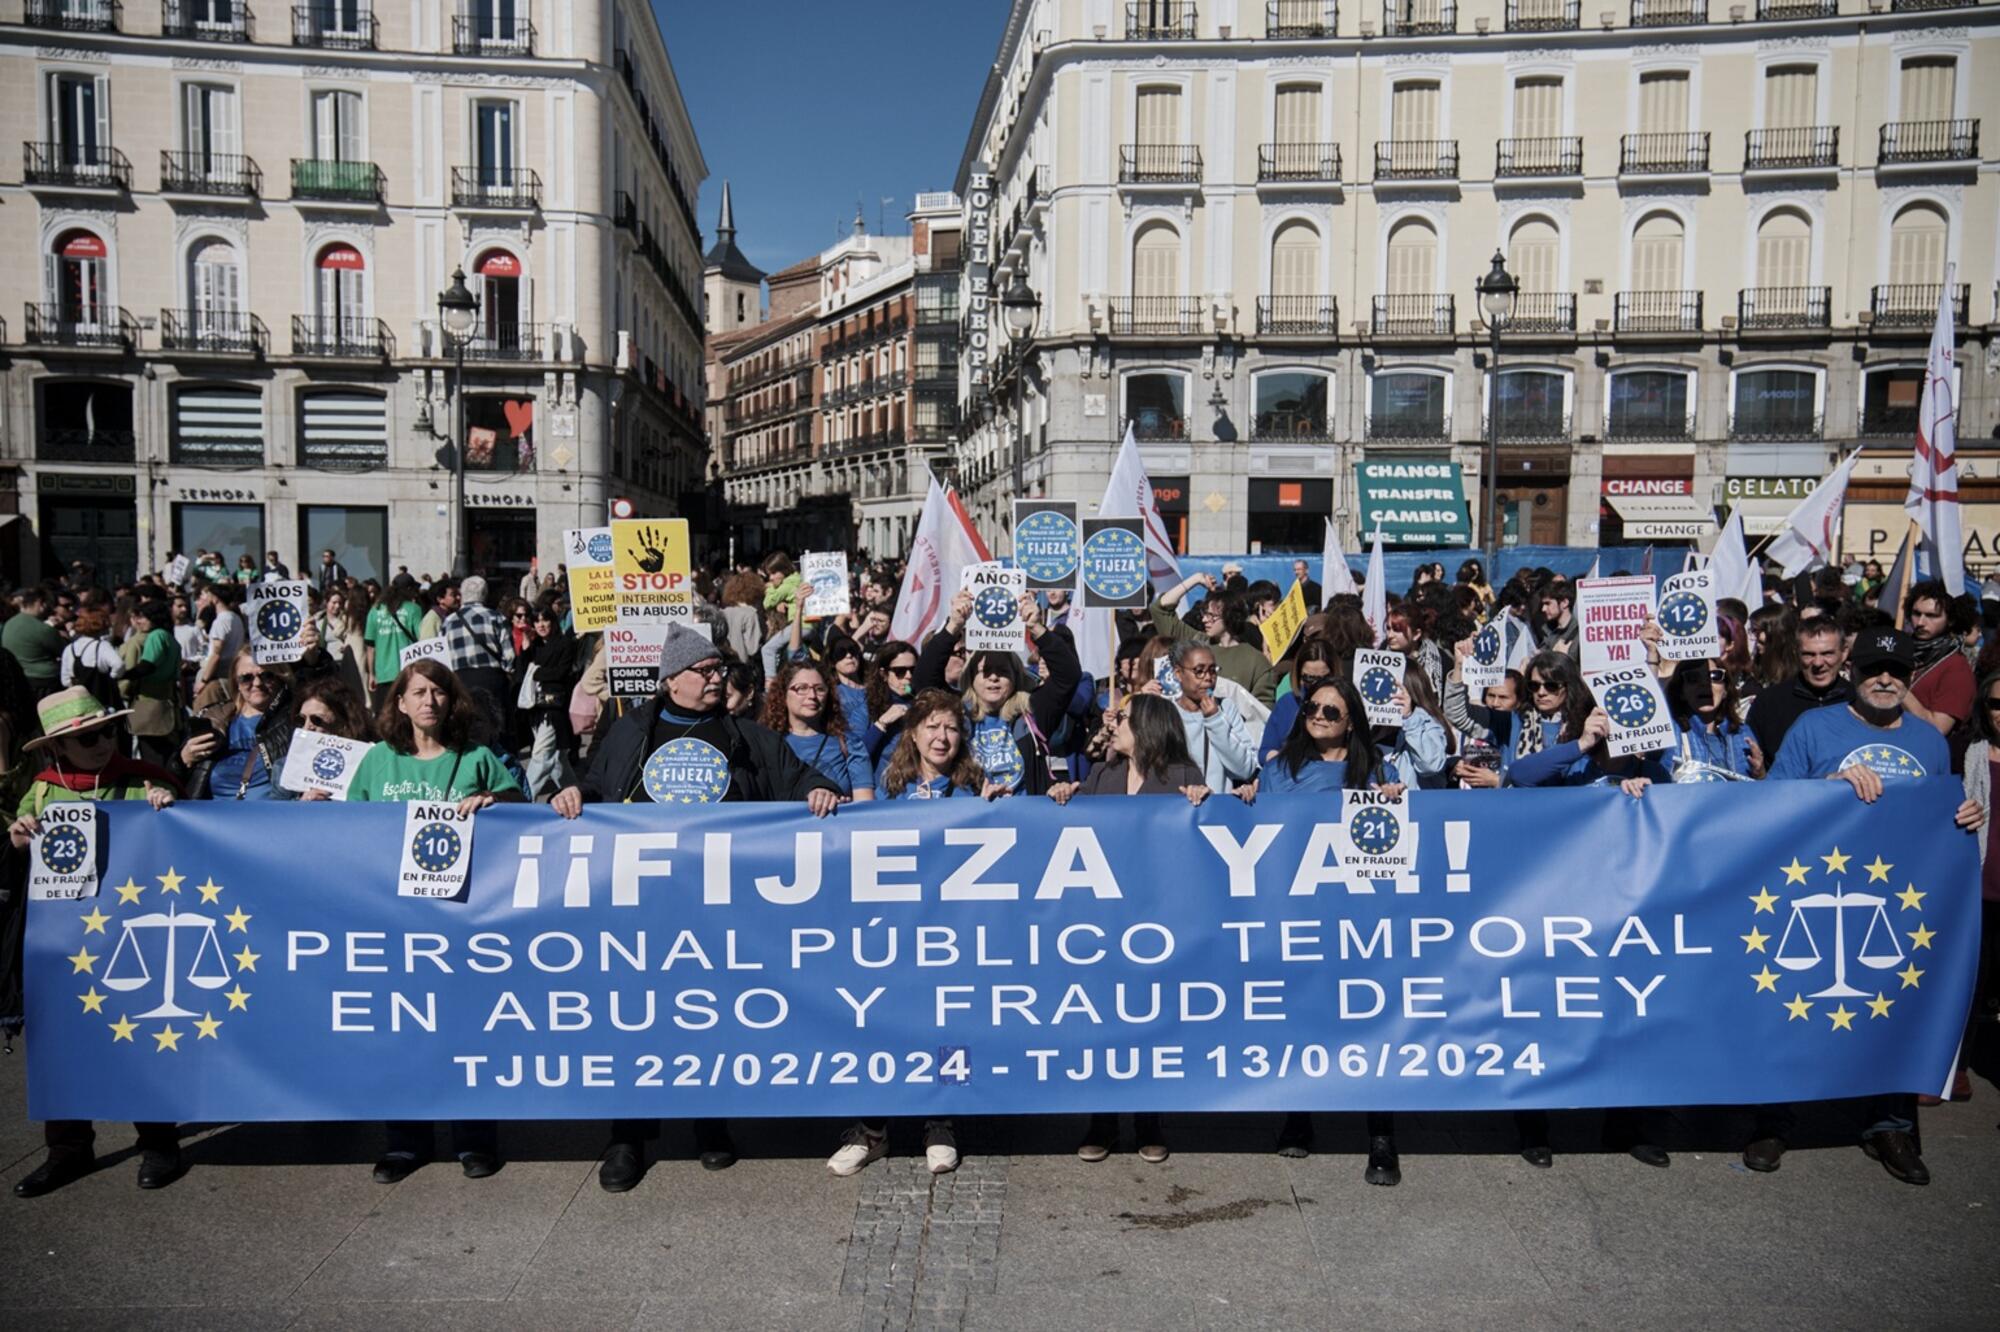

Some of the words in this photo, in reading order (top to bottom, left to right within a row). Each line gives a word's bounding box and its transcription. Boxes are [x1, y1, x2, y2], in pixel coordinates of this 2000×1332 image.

[971, 173, 989, 263] HOTEL
[971, 277, 988, 384] EUROPA
[1365, 465, 1452, 478] CHANGE
[1607, 480, 1685, 493] CHANGE
[1728, 479, 1817, 495] GELATO
[179, 489, 256, 500] SEPHORA
[464, 495, 534, 505] SEPHORA
[1153, 488, 1181, 501] nge
[1368, 488, 1454, 500] TRANSFER
[1370, 510, 1458, 523] CAMBIO
[1644, 525, 1703, 535] CHANGE
[1402, 534, 1436, 542] CHANGE
[1028, 542, 1068, 555] FIJEZA
[1095, 559, 1136, 572] FIJEZA
[589, 571, 600, 579] LA
[604, 570, 614, 579] LE
[623, 572, 683, 590] STOP
[974, 570, 1022, 585] AÑOS
[253, 584, 303, 600] AÑOS
[589, 581, 614, 591] 20/20
[583, 594, 615, 603] INCUM
[622, 593, 685, 603] INTERINOS
[577, 606, 590, 615] LA
[622, 607, 639, 616] EN
[643, 605, 688, 616] ABUSO
[985, 600, 1008, 615] 25
[1586, 603, 1648, 624] ¡HUELGA
[1671, 605, 1695, 622] 12
[268, 612, 290, 628] 10
[610, 630, 637, 642] NO,
[985, 630, 1024, 638] FRAUDE
[1585, 624, 1642, 643] GENERA
[253, 644, 267, 652] EN
[270, 641, 304, 651] FRAUD
[1477, 636, 1492, 652] 11
[1673, 636, 1717, 647] FRAUDE
[405, 642, 444, 661] AÑOS
[611, 645, 625, 653] NO
[627, 645, 663, 653] SOMOS
[1607, 645, 1630, 661] YA!
[1668, 651, 1681, 659] DE
[1685, 650, 1706, 658] LEY
[265, 654, 279, 662] DE
[1360, 653, 1402, 667] AÑOS
[612, 668, 649, 677] SOMOS
[1592, 668, 1646, 688] AÑOS
[1375, 677, 1384, 692] 7
[1617, 694, 1644, 713] 26
[1607, 732, 1622, 742] EN
[1626, 723, 1672, 739] FRAUDE
[1622, 743, 1637, 753] DE
[1641, 739, 1662, 750] LEY
[320, 757, 337, 771] 22
[663, 768, 713, 783] FIJEZA
[40, 806, 92, 823] AÑOS
[414, 804, 469, 822] AÑOS
[1363, 821, 1386, 839] 21
[53, 840, 77, 857] 23
[425, 838, 449, 856] 10
[512, 826, 1124, 908] ¡¡FIJEZA
[1345, 856, 1359, 864] EN
[1363, 856, 1407, 865] FRAUDE
[34, 876, 49, 885] EN
[53, 874, 96, 884] FRAUDE
[403, 873, 418, 881] EN
[422, 873, 464, 882] FRAUDE
[1356, 869, 1370, 878] DE
[1375, 870, 1395, 878] LEY
[46, 890, 61, 898] DE
[65, 889, 82, 898] LEY
[413, 887, 428, 895] DE
[431, 888, 450, 896] LEY
[287, 929, 763, 974] PERSONAL
[791, 917, 1175, 968] PÚBLICO
[1221, 914, 1713, 962] TEMPORAL
[331, 991, 437, 1032] EN
[482, 988, 789, 1031] ABUSO
[835, 987, 886, 1028] Y
[935, 980, 1286, 1027] FRAUDE
[1339, 977, 1447, 1020] DE
[1500, 975, 1667, 1019] LEY
[453, 1055, 615, 1088] TJUE
[634, 1049, 971, 1086] 22/02/2024
[992, 1066, 1009, 1074] -
[1025, 1046, 1185, 1081] TJUE
[1207, 1043, 1545, 1079] 13/06/2024
